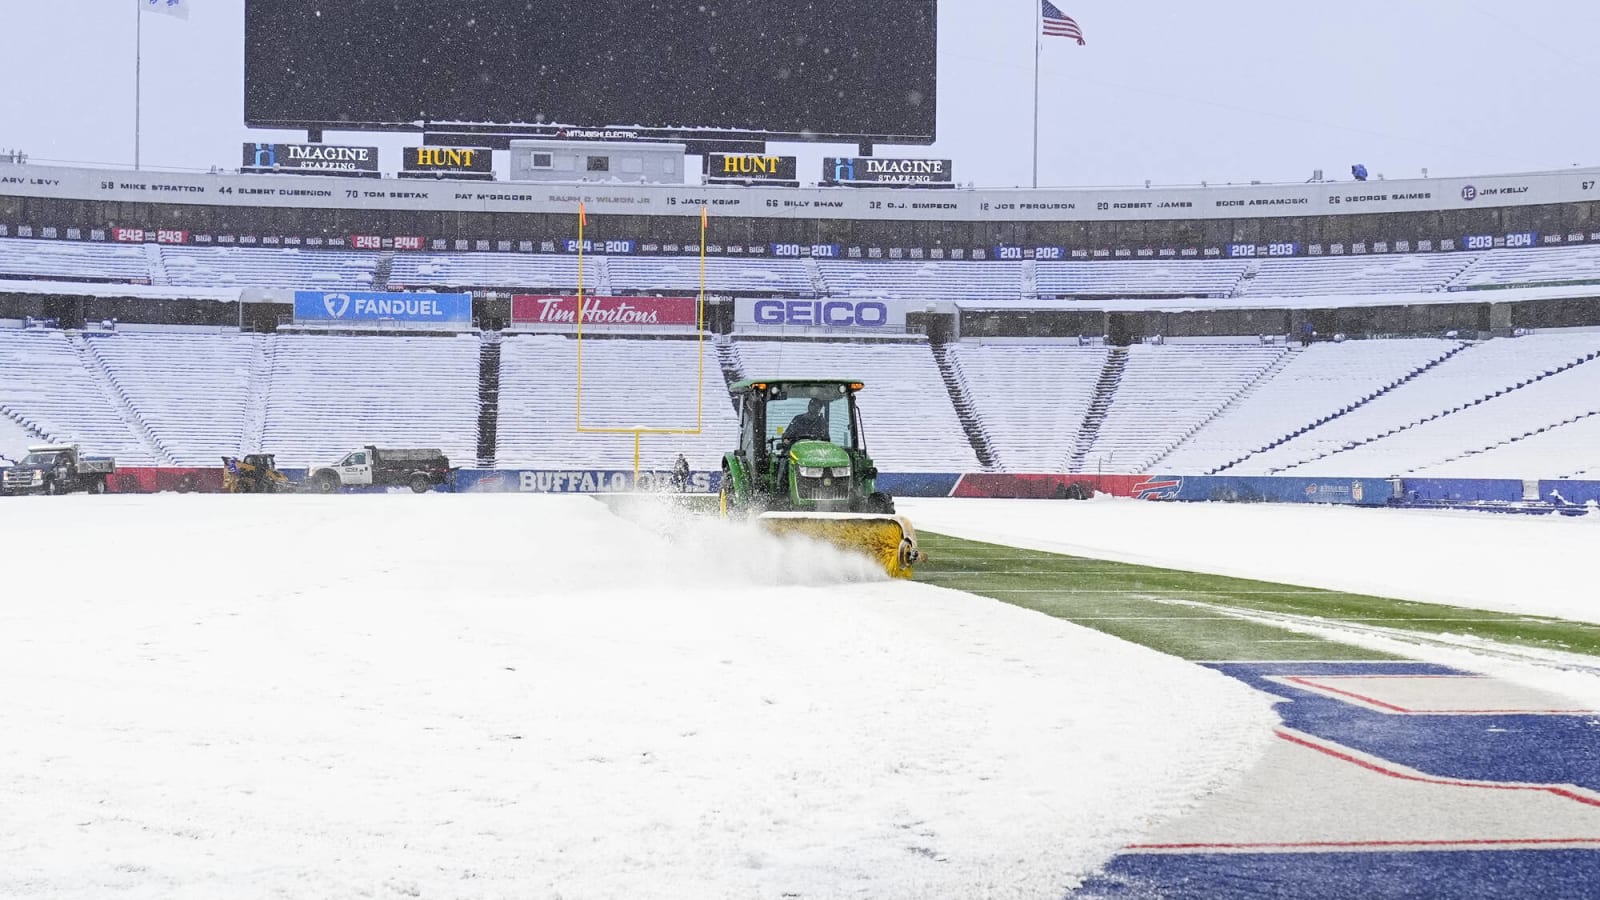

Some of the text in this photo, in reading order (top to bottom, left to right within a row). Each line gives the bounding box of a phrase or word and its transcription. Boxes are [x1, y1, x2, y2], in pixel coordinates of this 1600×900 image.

[566, 130, 638, 138] MITSUBISHI ELECTRIC
[288, 146, 369, 162] IMAGINE
[416, 148, 474, 167] HUNT
[300, 161, 356, 170] STAFFING
[724, 156, 780, 173] HUNT
[866, 159, 944, 173] IMAGINE
[878, 174, 930, 182] STAFFING
[101, 181, 114, 190] 58
[218, 186, 232, 194] 44
[1582, 181, 1595, 190] 67
[346, 190, 358, 198] 70
[1462, 188, 1474, 198] 12
[1500, 186, 1529, 194] KELLY
[666, 197, 676, 205] 15
[766, 199, 778, 207] 66
[869, 201, 882, 209] 32
[980, 202, 990, 210] 12
[1097, 202, 1109, 210] 20
[1328, 196, 1340, 204] 26
[118, 229, 143, 241] 242
[158, 230, 182, 243] 243
[1468, 236, 1492, 248] 203
[1506, 234, 1530, 246] 204
[356, 236, 381, 248] 243
[394, 236, 419, 249] 244
[568, 240, 592, 251] 244
[606, 242, 630, 252] 200
[776, 244, 800, 256] 200
[812, 245, 833, 256] 201
[1000, 248, 1022, 258] 201
[1036, 248, 1059, 258] 202
[1232, 245, 1256, 256] 202
[1270, 244, 1293, 255] 203
[354, 299, 442, 316] FANDUEL
[537, 298, 658, 324] Tim Hortons
[754, 300, 888, 326] GEICO
[519, 471, 626, 492] BUFFALO
